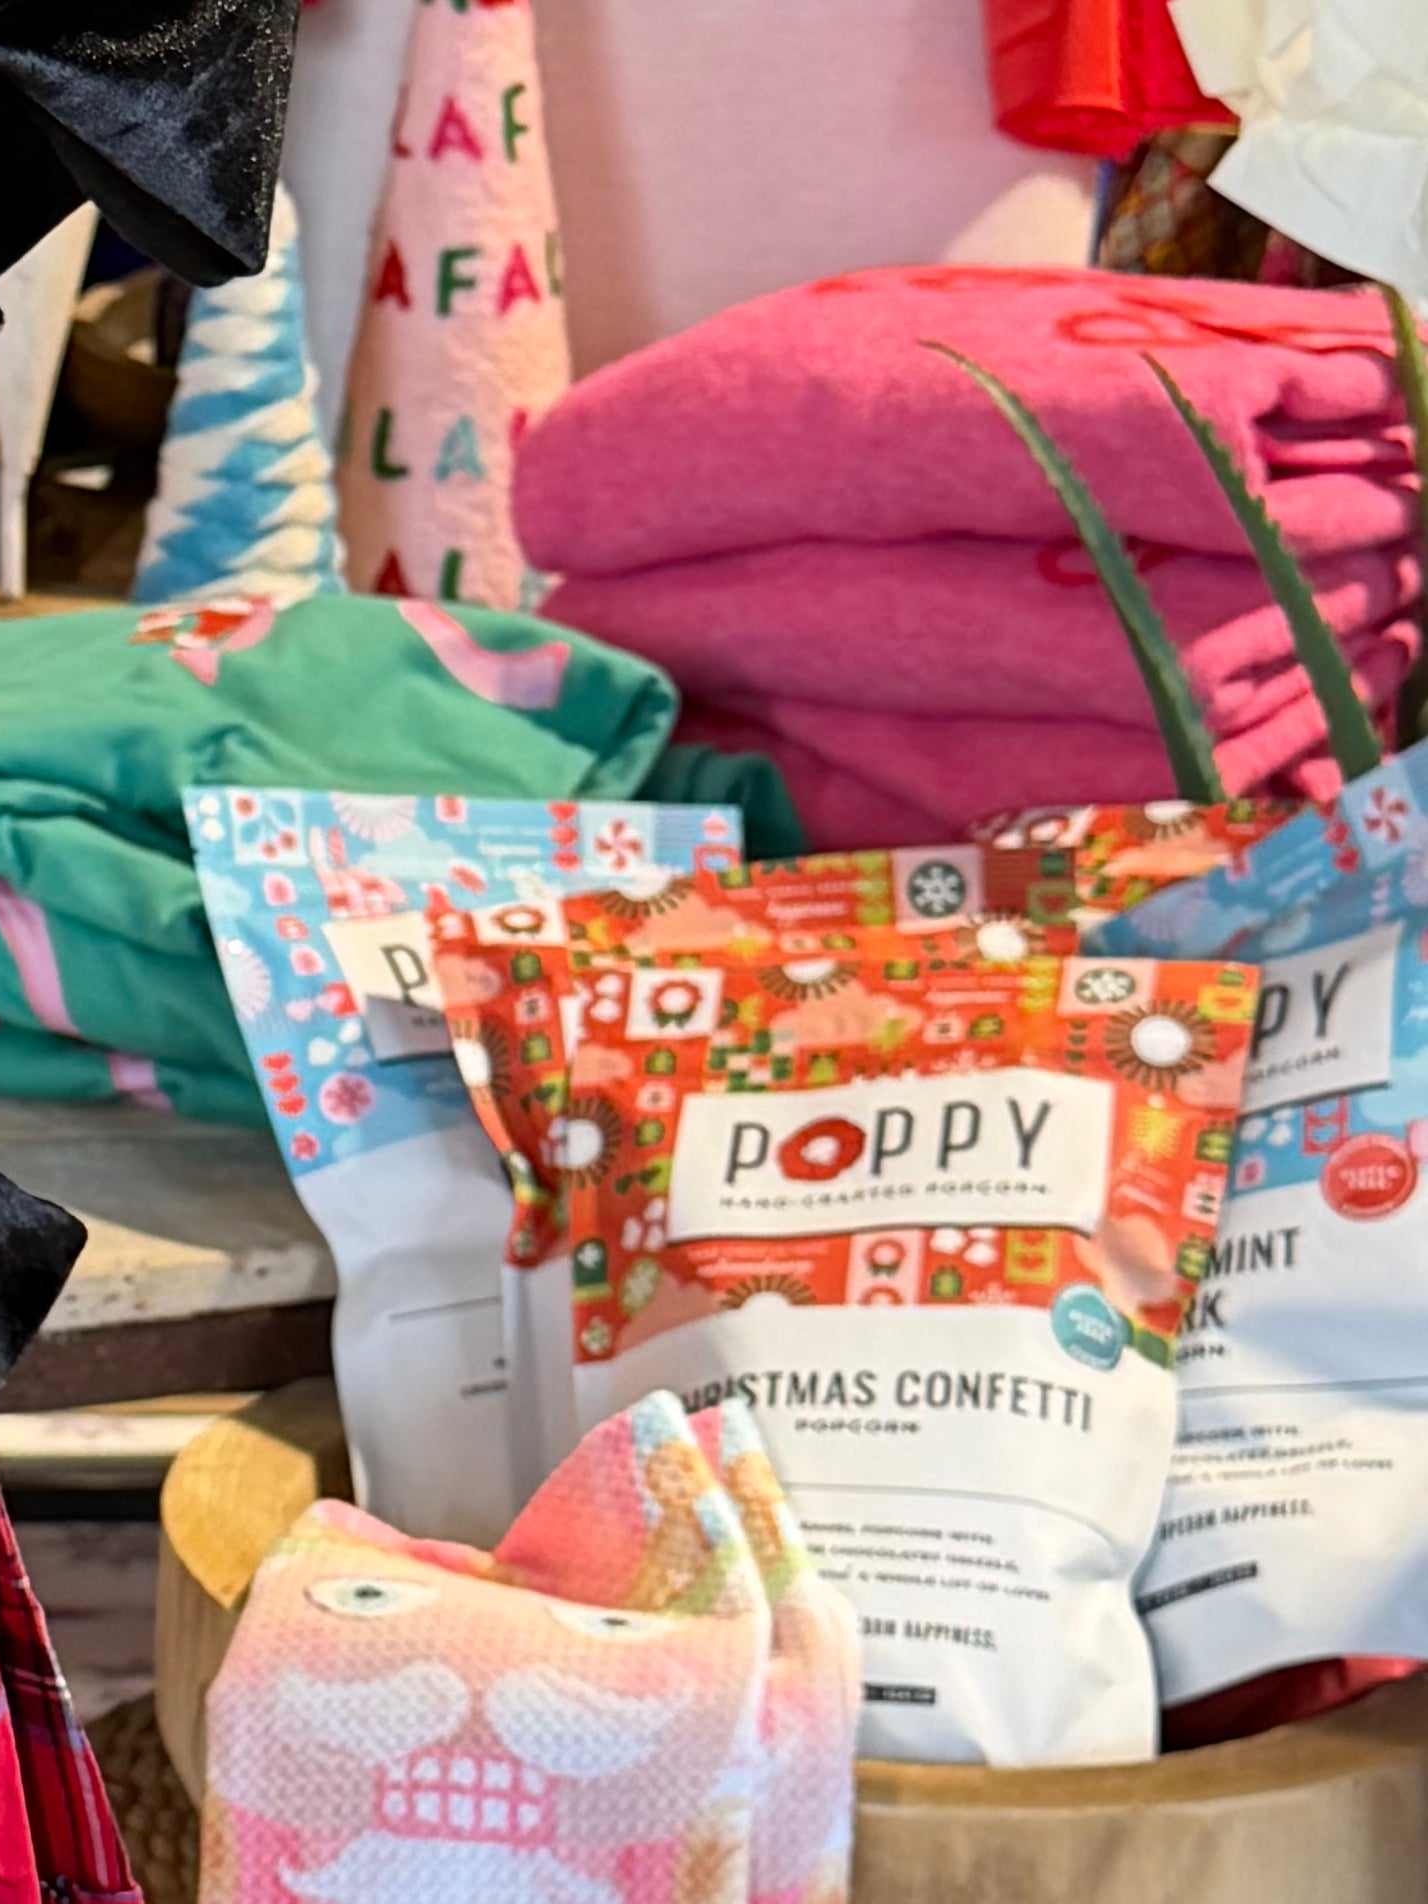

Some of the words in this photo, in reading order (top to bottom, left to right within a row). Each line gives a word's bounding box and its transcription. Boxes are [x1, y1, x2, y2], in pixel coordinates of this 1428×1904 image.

[725, 1096, 1052, 1185] POPPY
[1204, 1225, 1301, 1280] MINT
[681, 1368, 877, 1415] HRISTMAS
[894, 1368, 1094, 1434] CONFETTI
